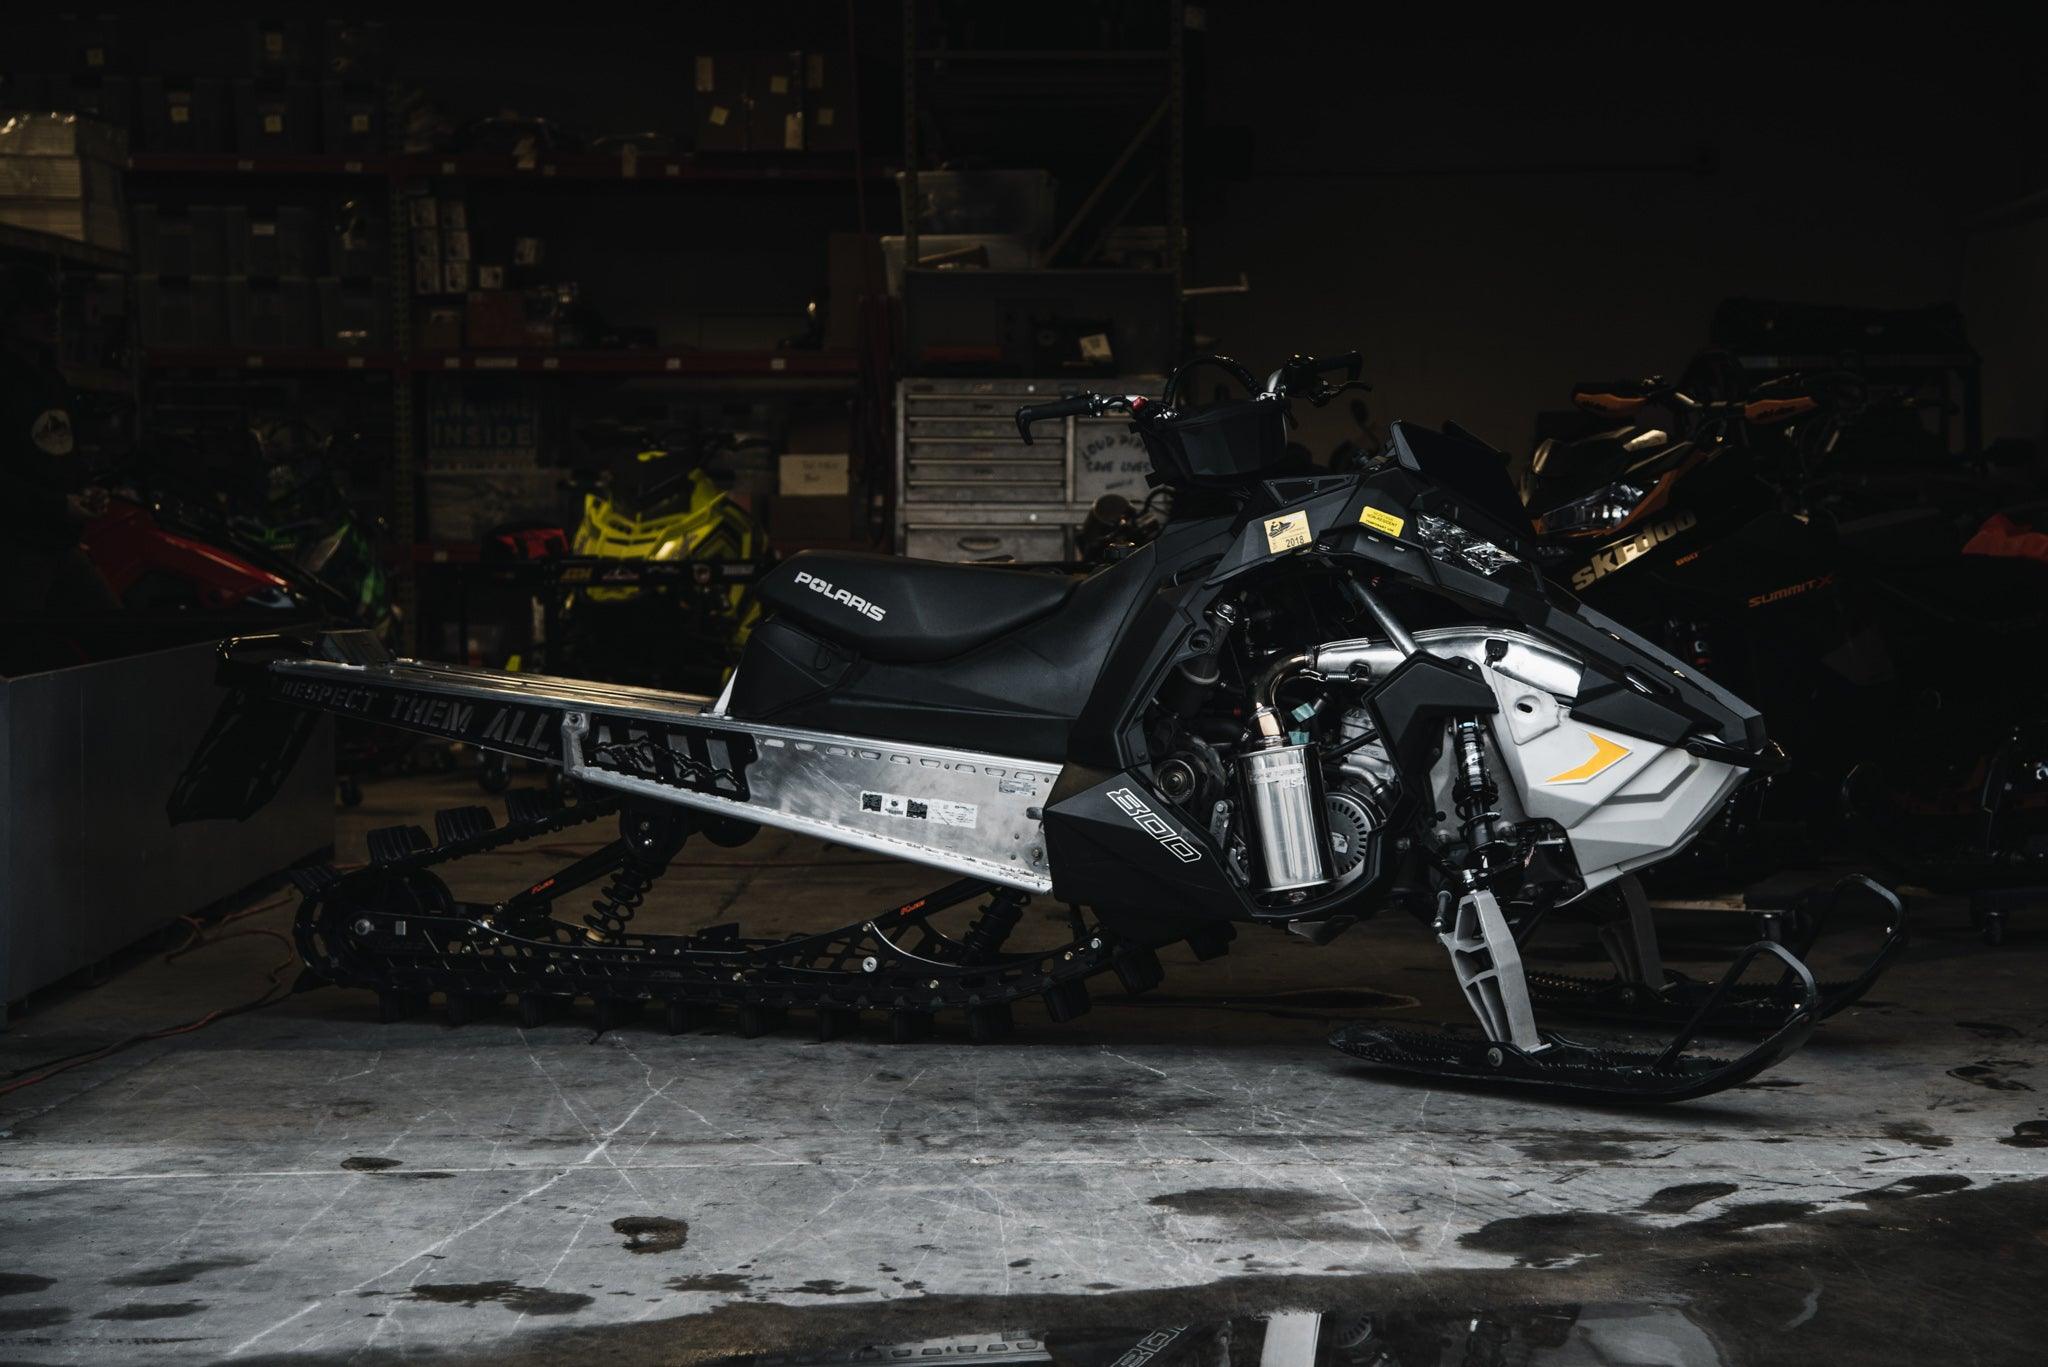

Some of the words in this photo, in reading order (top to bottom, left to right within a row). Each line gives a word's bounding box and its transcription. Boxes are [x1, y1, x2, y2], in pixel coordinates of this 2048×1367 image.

[1286, 536, 1305, 548] 2018
[794, 571, 887, 622] POLARIS
[281, 679, 380, 713] RESPECT
[390, 693, 476, 735] THEM
[481, 705, 551, 752] ALL
[1106, 787, 1202, 863] 800
